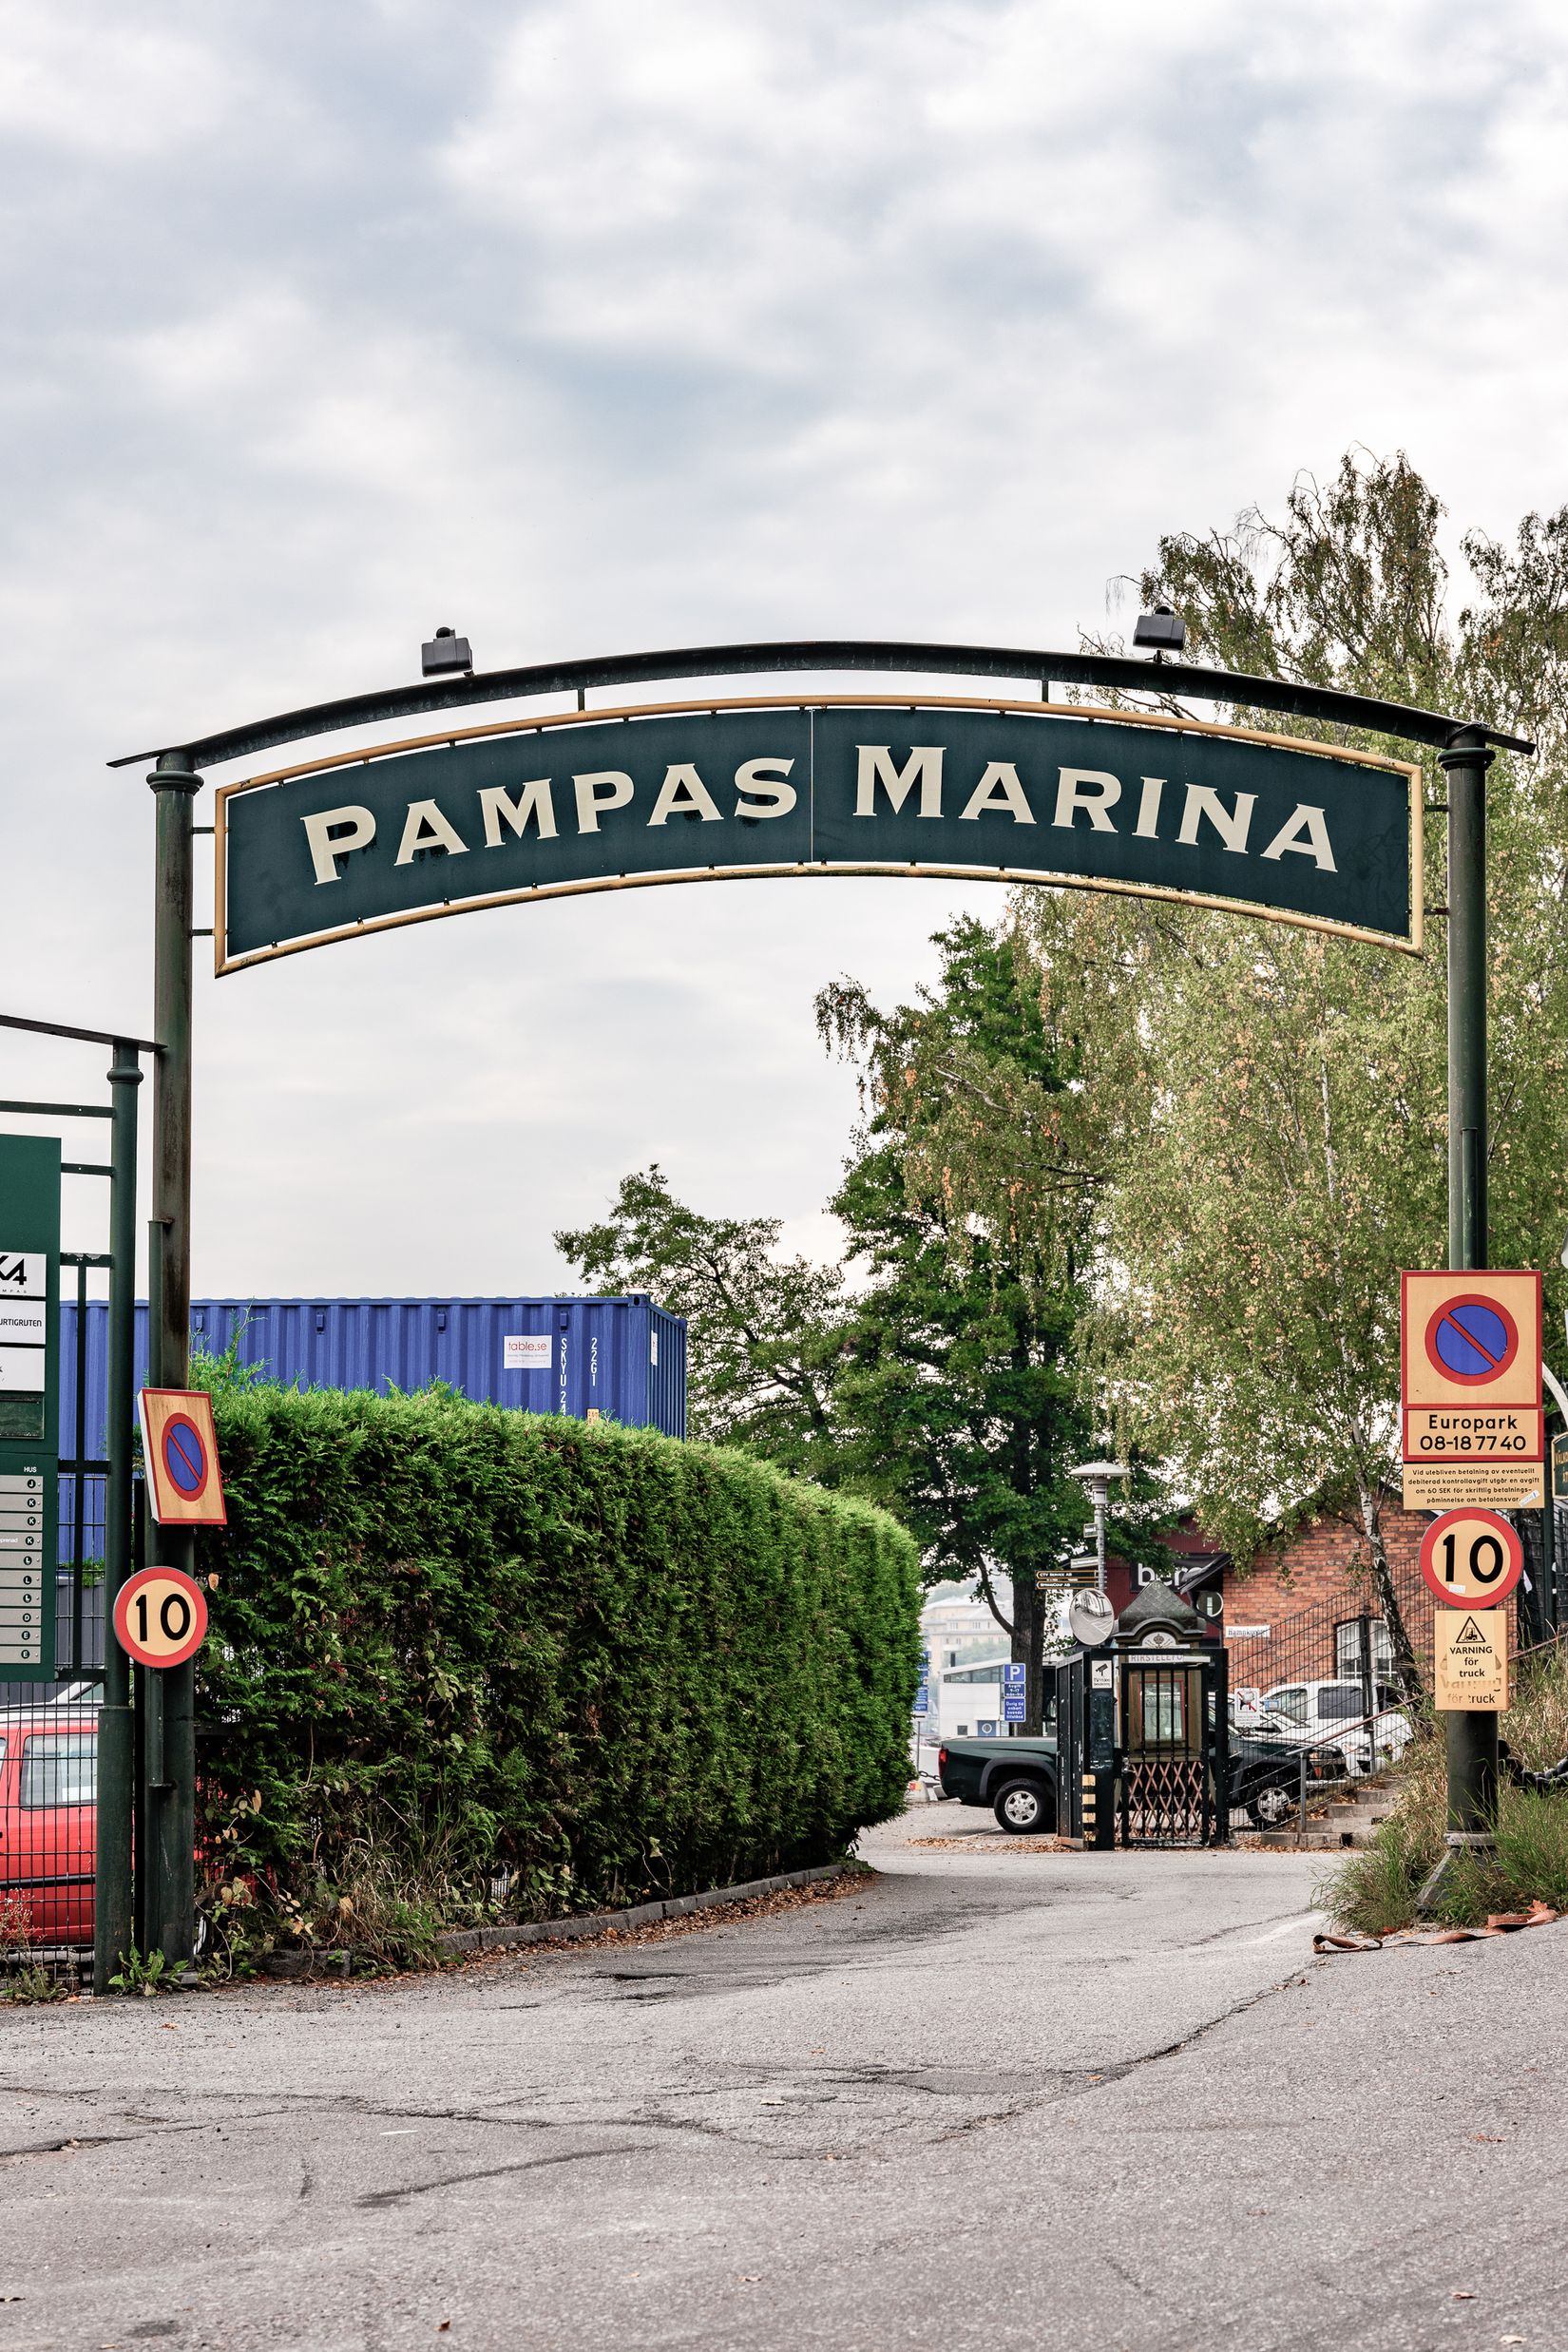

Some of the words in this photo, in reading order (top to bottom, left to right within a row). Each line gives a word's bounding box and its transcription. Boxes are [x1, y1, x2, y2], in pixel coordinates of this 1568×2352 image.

[301, 756, 797, 886] PAMPAS
[853, 744, 1339, 872] MARINA
[508, 1342, 546, 1350] table.se
[1428, 1414, 1518, 1433] Europark
[1420, 1436, 1472, 1450] 08-18
[1443, 1534, 1503, 1583] 10
[135, 1593, 191, 1642] 10
[1464, 1657, 1479, 1666] för
[1010, 1666, 1021, 1681] P
[1459, 1668, 1485, 1677] truck
